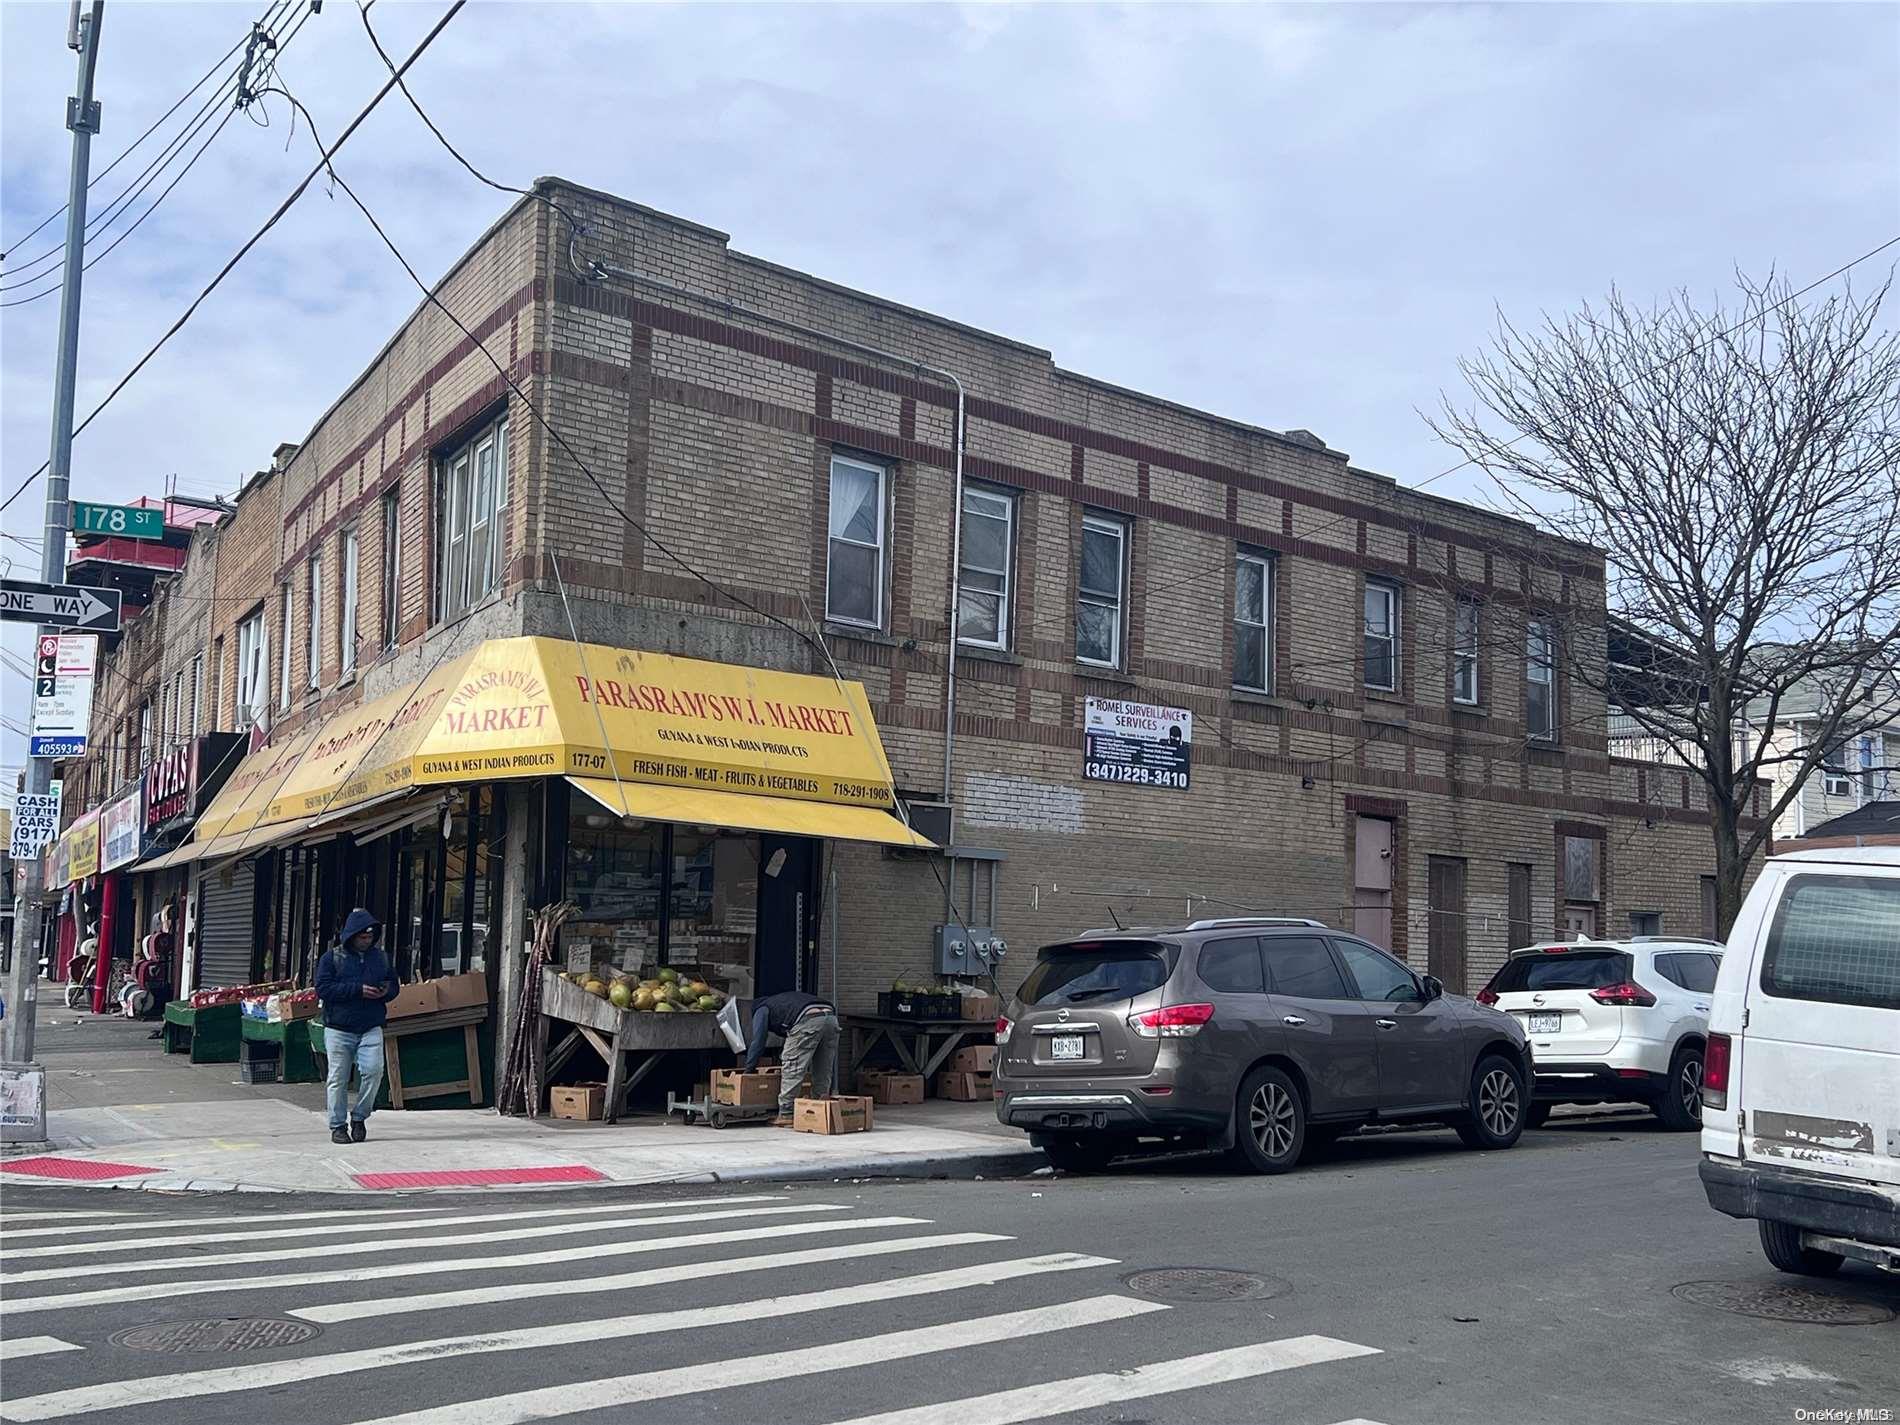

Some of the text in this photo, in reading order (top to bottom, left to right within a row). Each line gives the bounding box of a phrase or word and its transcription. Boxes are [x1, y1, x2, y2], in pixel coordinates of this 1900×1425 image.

[84, 507, 151, 532] 178 ST
[0, 592, 93, 615] ONE WAY
[42, 679, 52, 696] 2
[575, 676, 723, 722] PARASRAM'S
[764, 701, 854, 737] MARKET
[1096, 700, 1181, 722] ROMEL SURVEILLANCE
[443, 704, 550, 735] MARKET
[1115, 715, 1158, 731] SERVICES
[657, 728, 695, 744] GUYANA
[696, 734, 704, 745] &
[704, 734, 730, 748] WEST
[762, 742, 809, 758] PRODUCTS
[422, 752, 555, 774] GUYANA & WEST INDIAN PRODUCTS
[571, 752, 606, 769] 177-07
[633, 759, 664, 777] FRESH
[666, 761, 688, 779] FISH
[695, 767, 719, 782] MEAT
[725, 770, 756, 787] FRUITS
[758, 774, 765, 787] &
[767, 775, 819, 793] VEGETABLES
[1085, 762, 1187, 788] (347)229-3410
[17, 795, 58, 808] CASH
[833, 782, 890, 801] 718-291-1908
[17, 807, 57, 817] FOR ALL
[18, 816, 54, 828] CARS
[14, 827, 56, 843] (917)
[11, 841, 47, 858] 379-1
